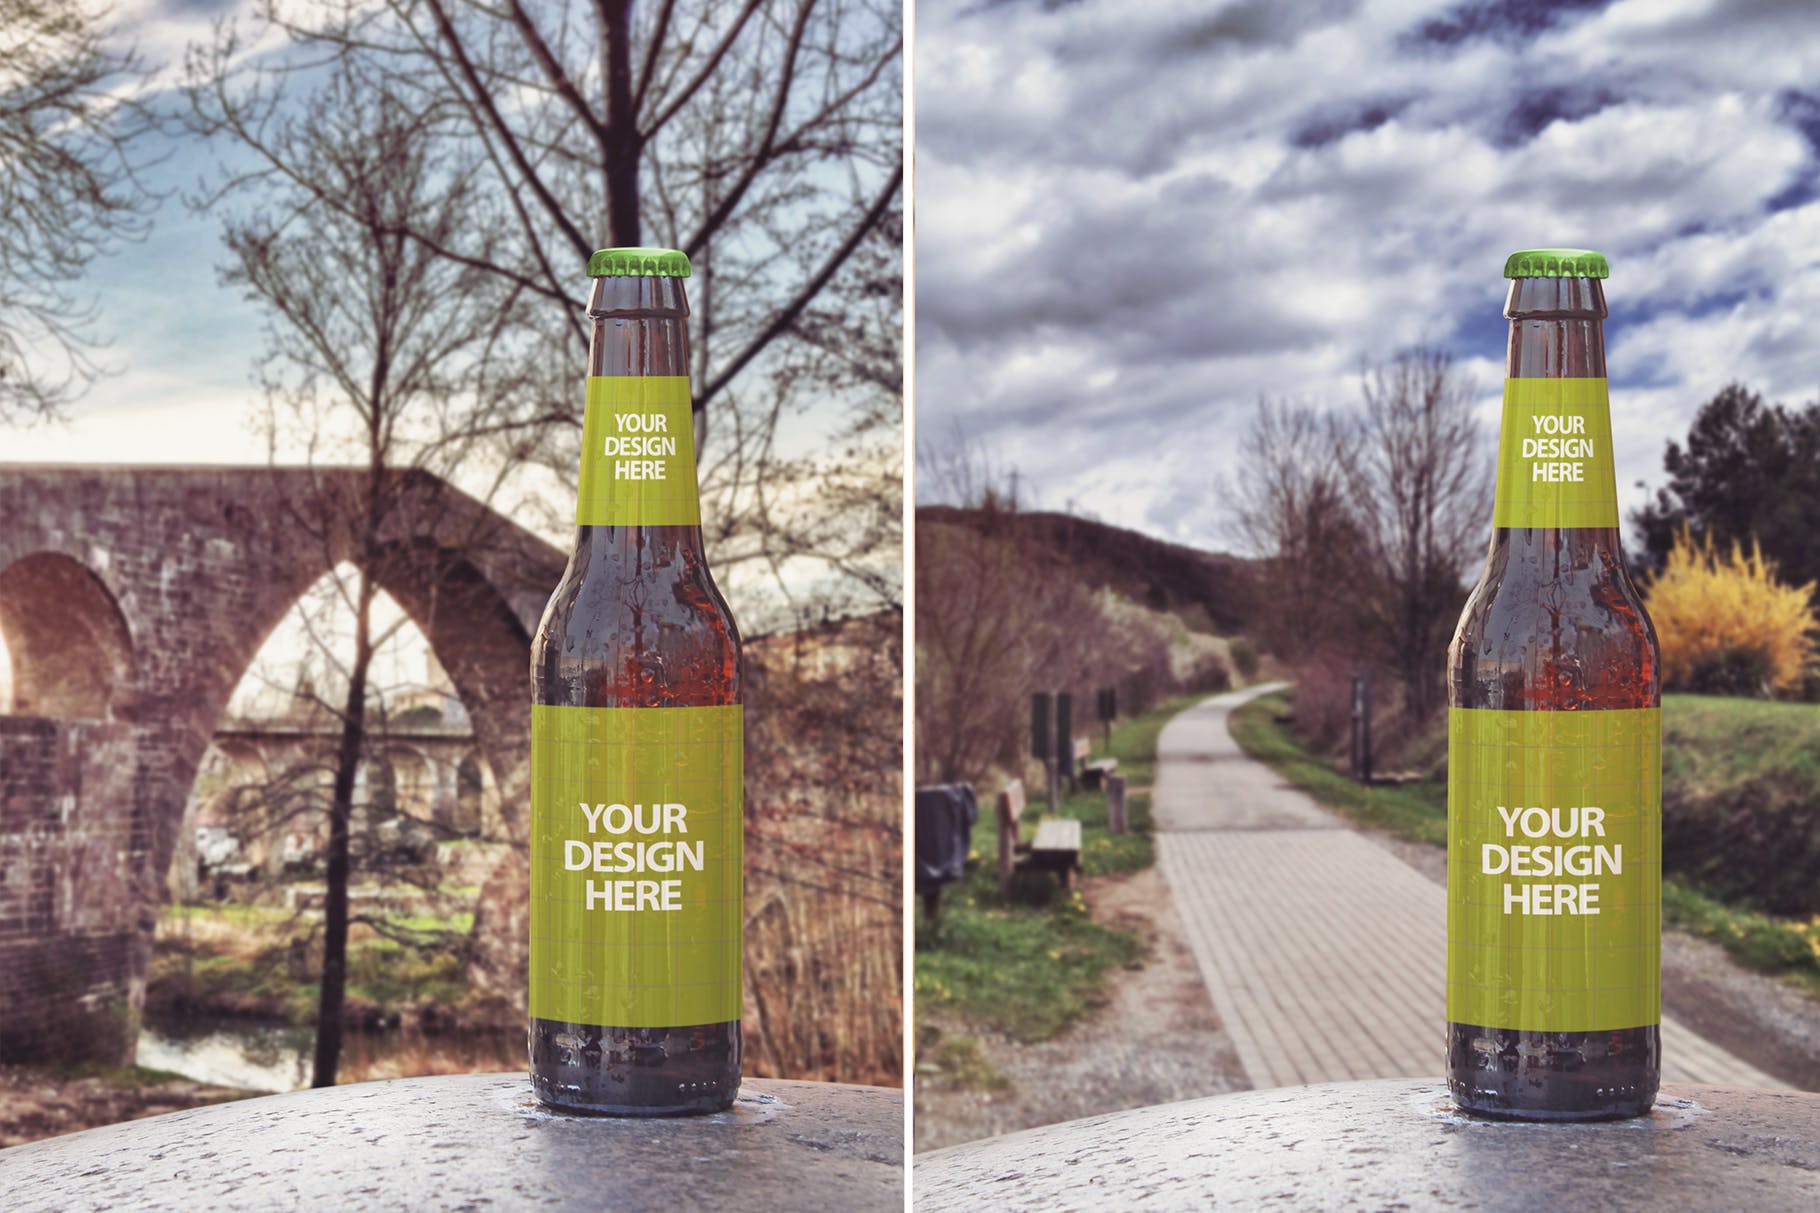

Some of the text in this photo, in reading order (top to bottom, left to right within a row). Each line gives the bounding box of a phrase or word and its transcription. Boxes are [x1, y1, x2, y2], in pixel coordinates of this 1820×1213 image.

[615, 413, 667, 433] YOUR
[1532, 416, 1585, 435] YOUR
[604, 437, 676, 456] DESIGN
[1521, 439, 1594, 458] DESIGN
[614, 460, 667, 480] HERE
[1532, 462, 1584, 482] HERE
[579, 803, 688, 834] YOUR
[1496, 807, 1606, 837] YOUR
[564, 840, 704, 872] DESIGN
[1481, 844, 1622, 876] DESIGN
[586, 880, 683, 912] HERE
[1503, 884, 1601, 915] HERE
